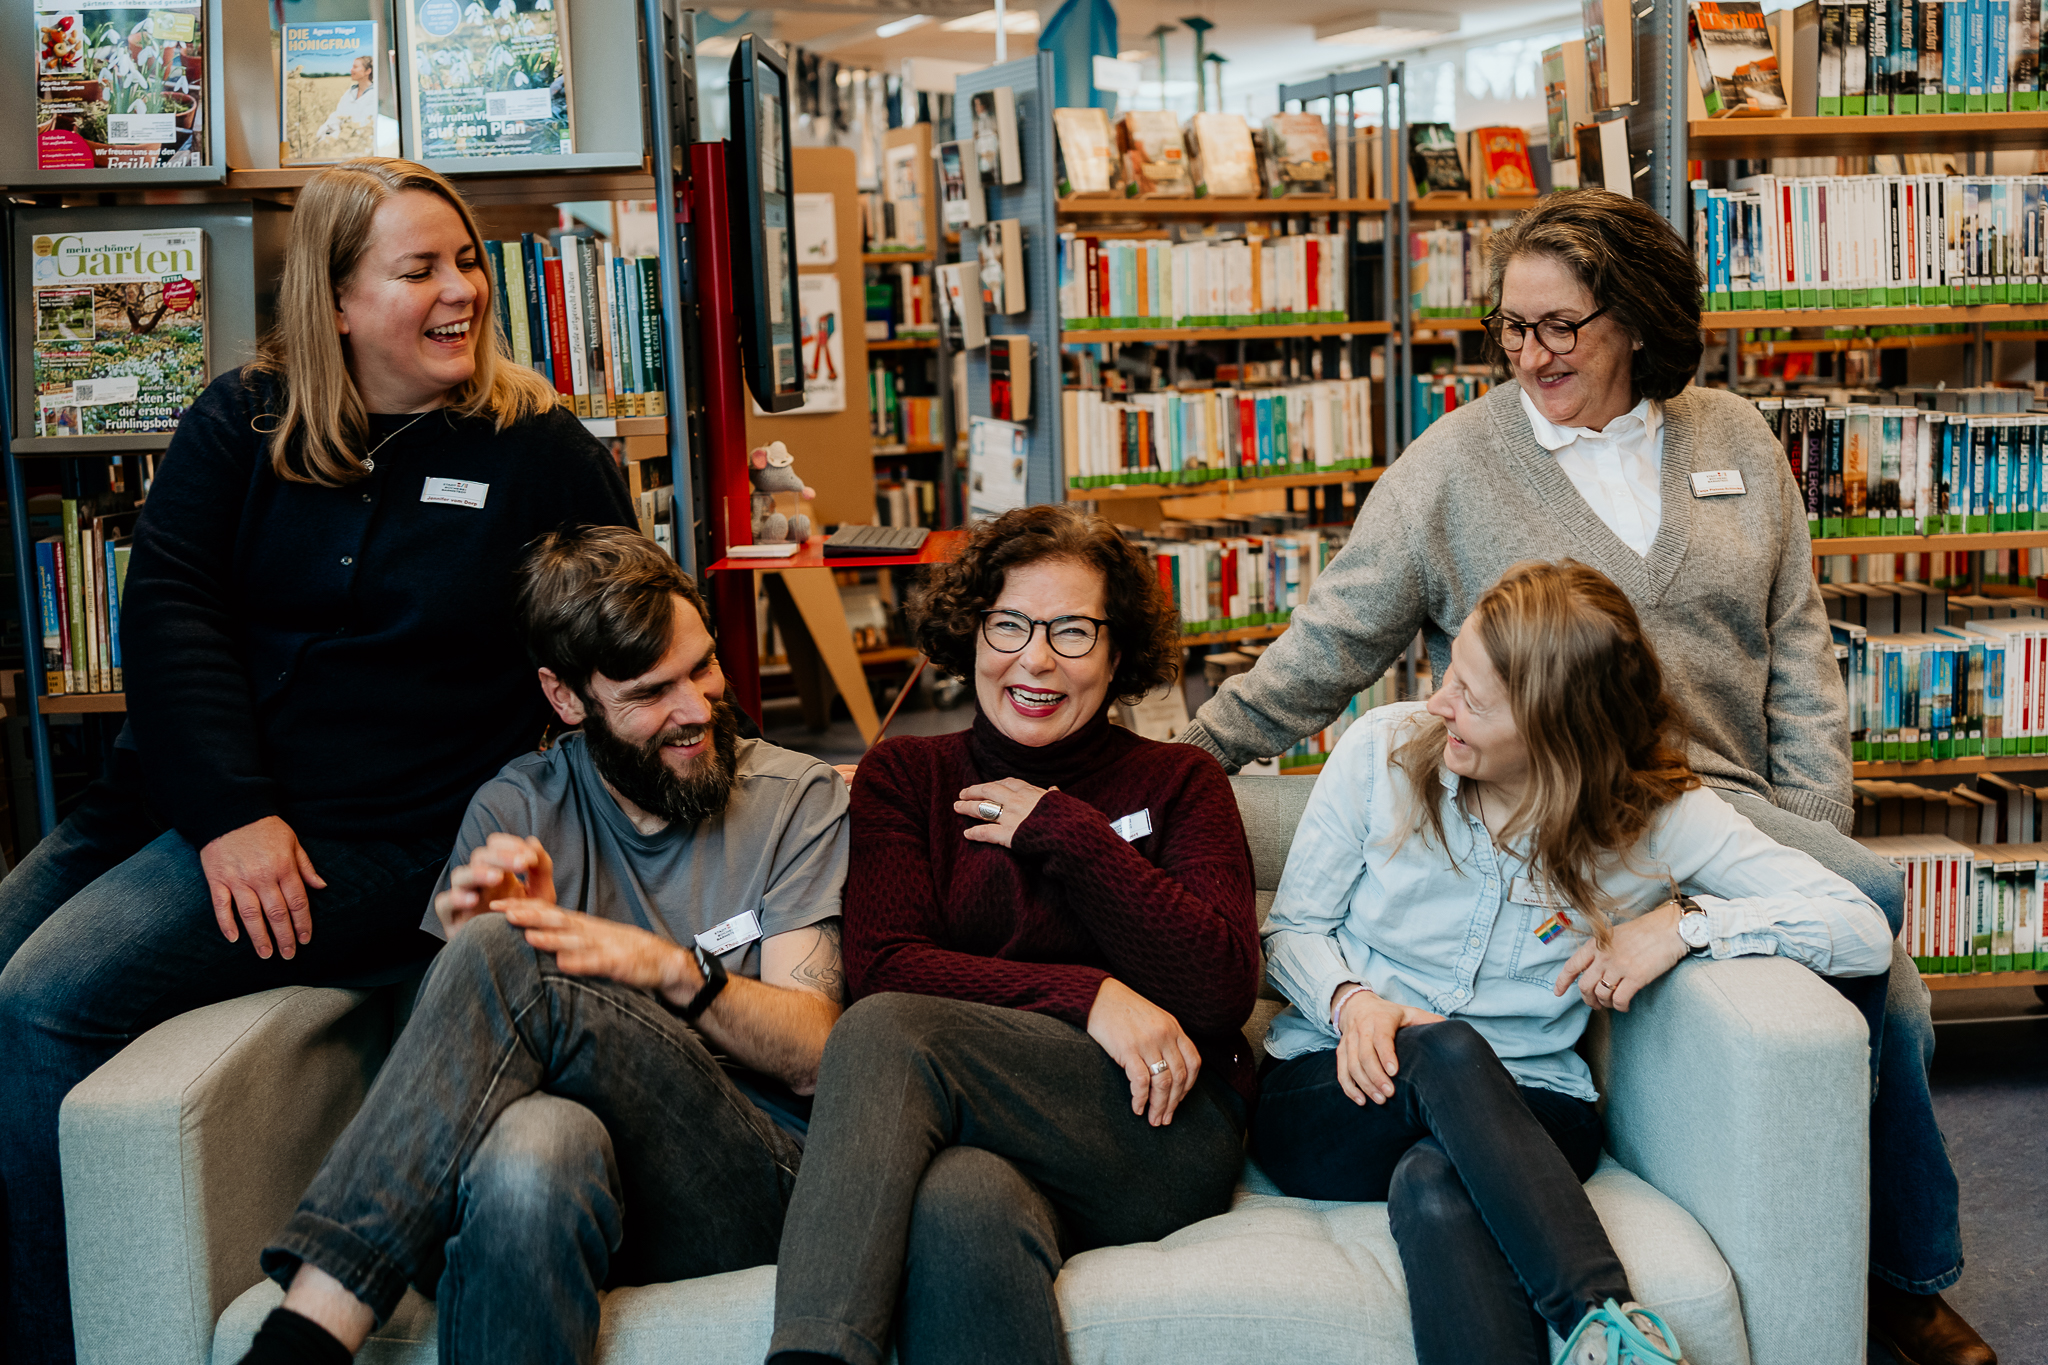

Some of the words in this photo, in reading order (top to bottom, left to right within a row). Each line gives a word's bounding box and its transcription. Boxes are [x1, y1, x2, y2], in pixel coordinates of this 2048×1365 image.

[288, 28, 309, 40] DIE
[1874, 15, 1888, 57] ALMSTÄDT
[1901, 8, 1914, 49] ALMSTÄDT
[288, 38, 360, 51] HONIGFRAU
[427, 113, 445, 123] Wir
[446, 112, 474, 122] rufen
[428, 124, 455, 139] auf
[457, 123, 488, 137] den
[490, 121, 526, 135] Plan
[51, 235, 195, 278] Garten
[66, 245, 91, 253] mein
[94, 243, 135, 253] schöner
[162, 275, 183, 283] EXTRA
[567, 272, 577, 294] halten
[583, 247, 595, 298] Stallapotheke
[647, 270, 655, 309] REBANKS
[569, 295, 580, 331] artgerecht
[587, 300, 596, 320] Endes
[589, 322, 599, 348] Doktor
[642, 315, 651, 344] LEBEN
[650, 315, 659, 350] SCHÄFER
[644, 345, 653, 369] MEIN
[138, 393, 164, 404] cken
[166, 392, 182, 403] Sie
[118, 407, 136, 417] die
[138, 407, 173, 416] ersten
[105, 418, 179, 431] Frühlingsbote
